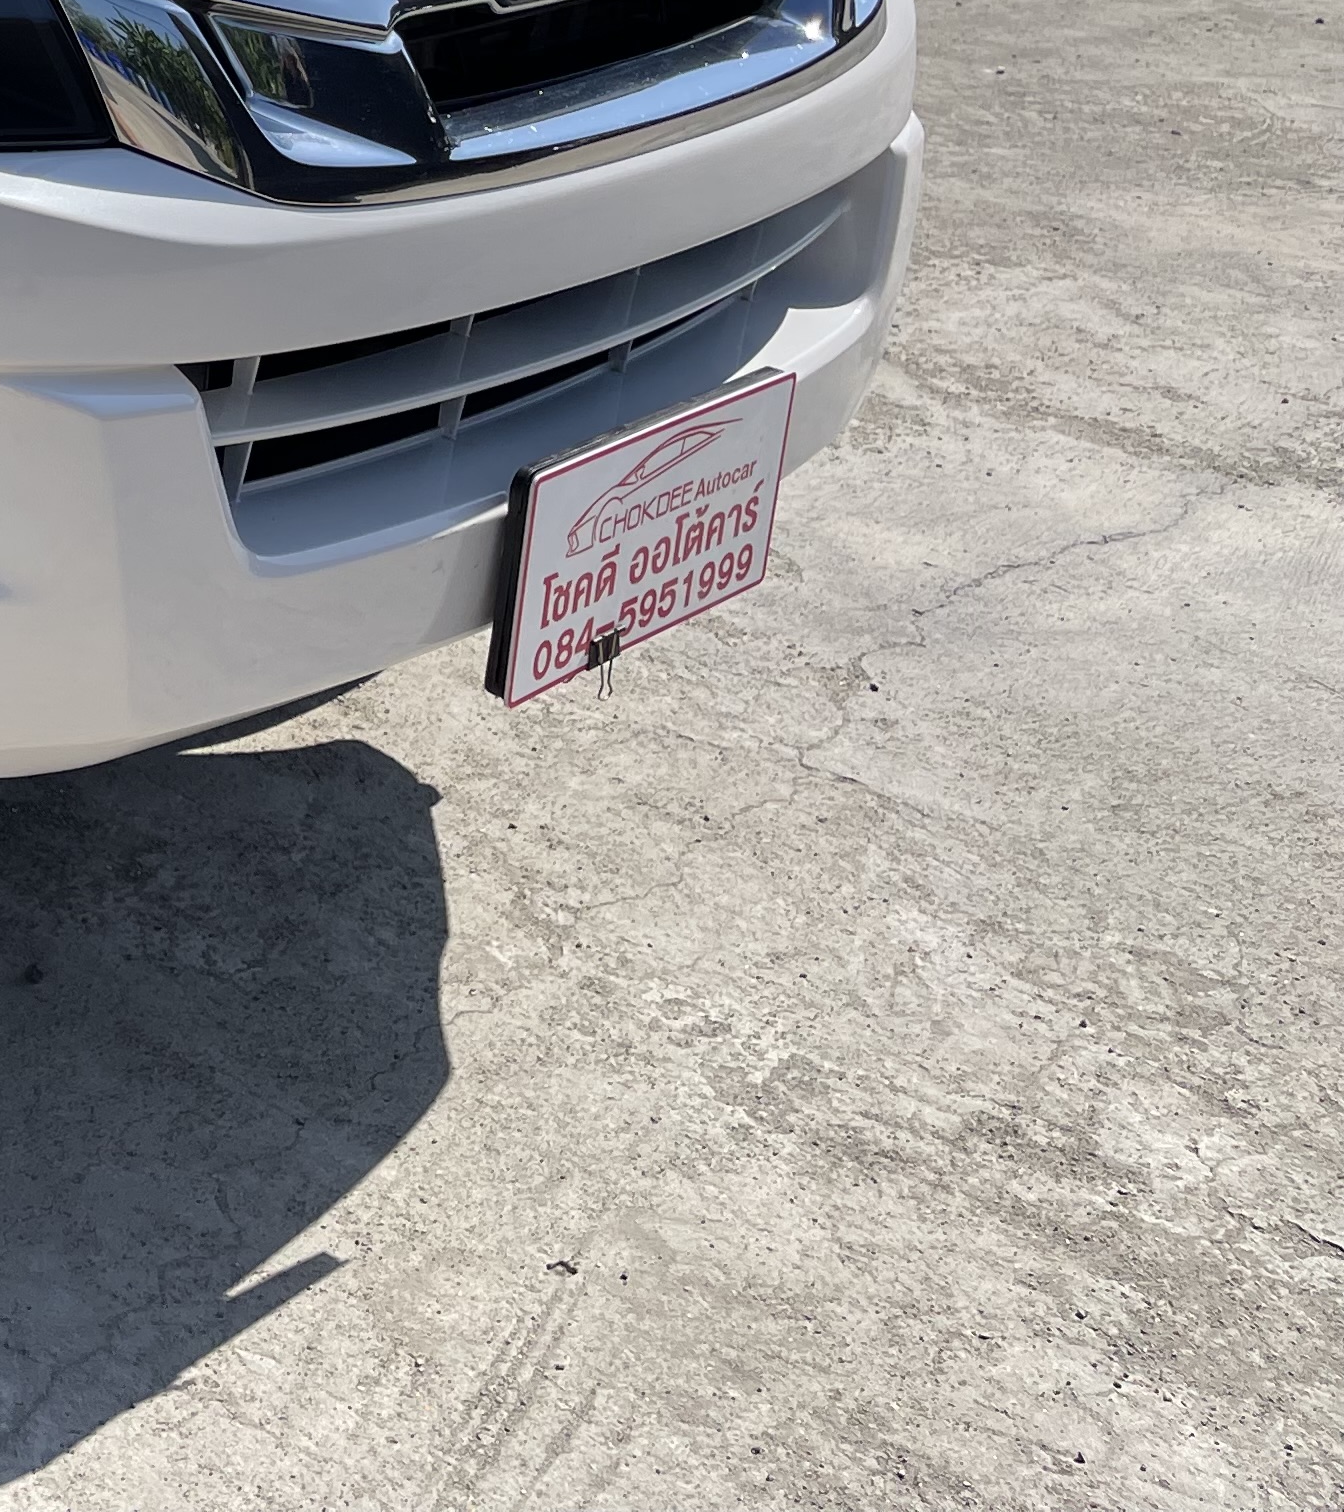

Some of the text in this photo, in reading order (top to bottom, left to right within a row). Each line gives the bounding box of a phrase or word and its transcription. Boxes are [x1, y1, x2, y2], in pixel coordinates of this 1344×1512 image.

[540, 478, 765, 630] โชคดี ออโต้คาร์
[599, 460, 758, 544] CHOKDEE Autocar
[532, 543, 754, 681] 084-5951999
